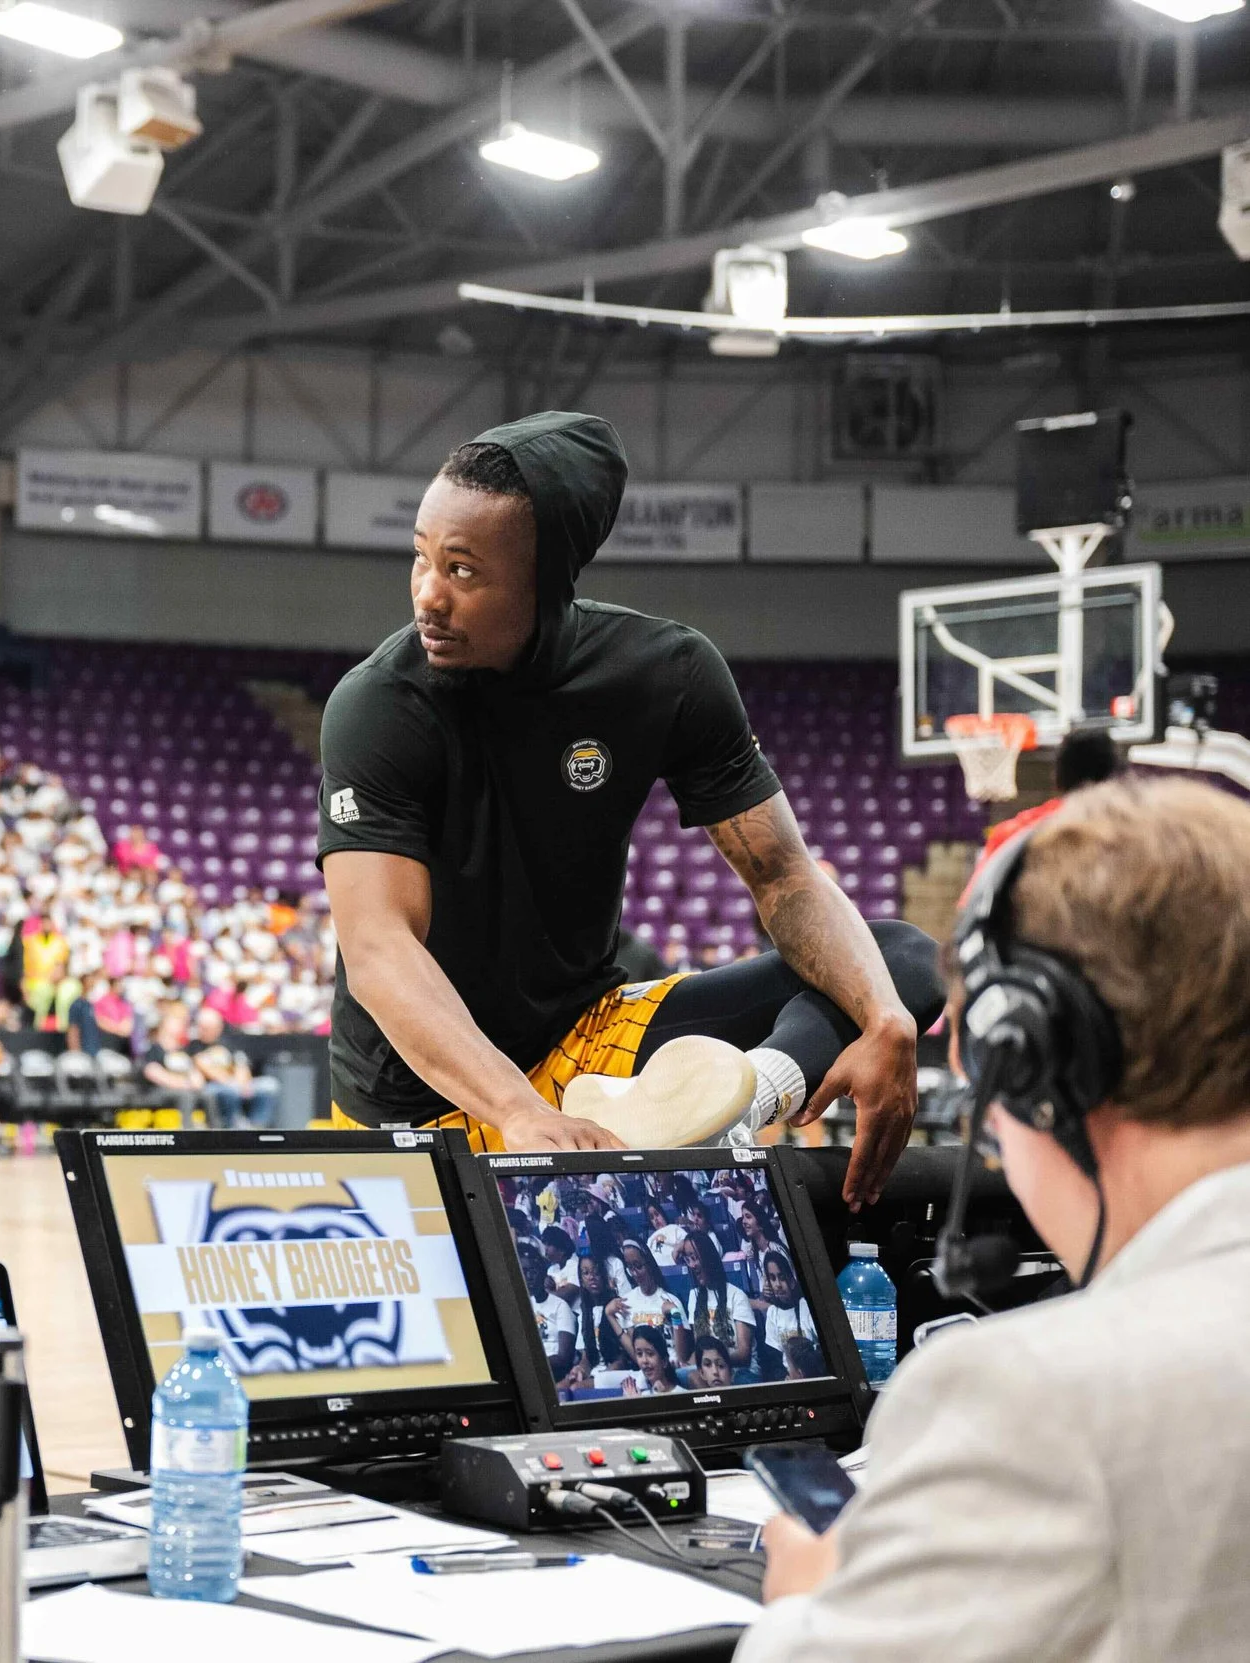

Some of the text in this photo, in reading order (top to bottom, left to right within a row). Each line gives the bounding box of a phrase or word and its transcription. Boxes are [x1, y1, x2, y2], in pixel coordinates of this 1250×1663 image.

[134, 1134, 175, 1146] SCIENTIFIC
[489, 1156, 554, 1169] FLANDERS SCIENTIFIC
[176, 1239, 421, 1306] HONEY BADGERS
